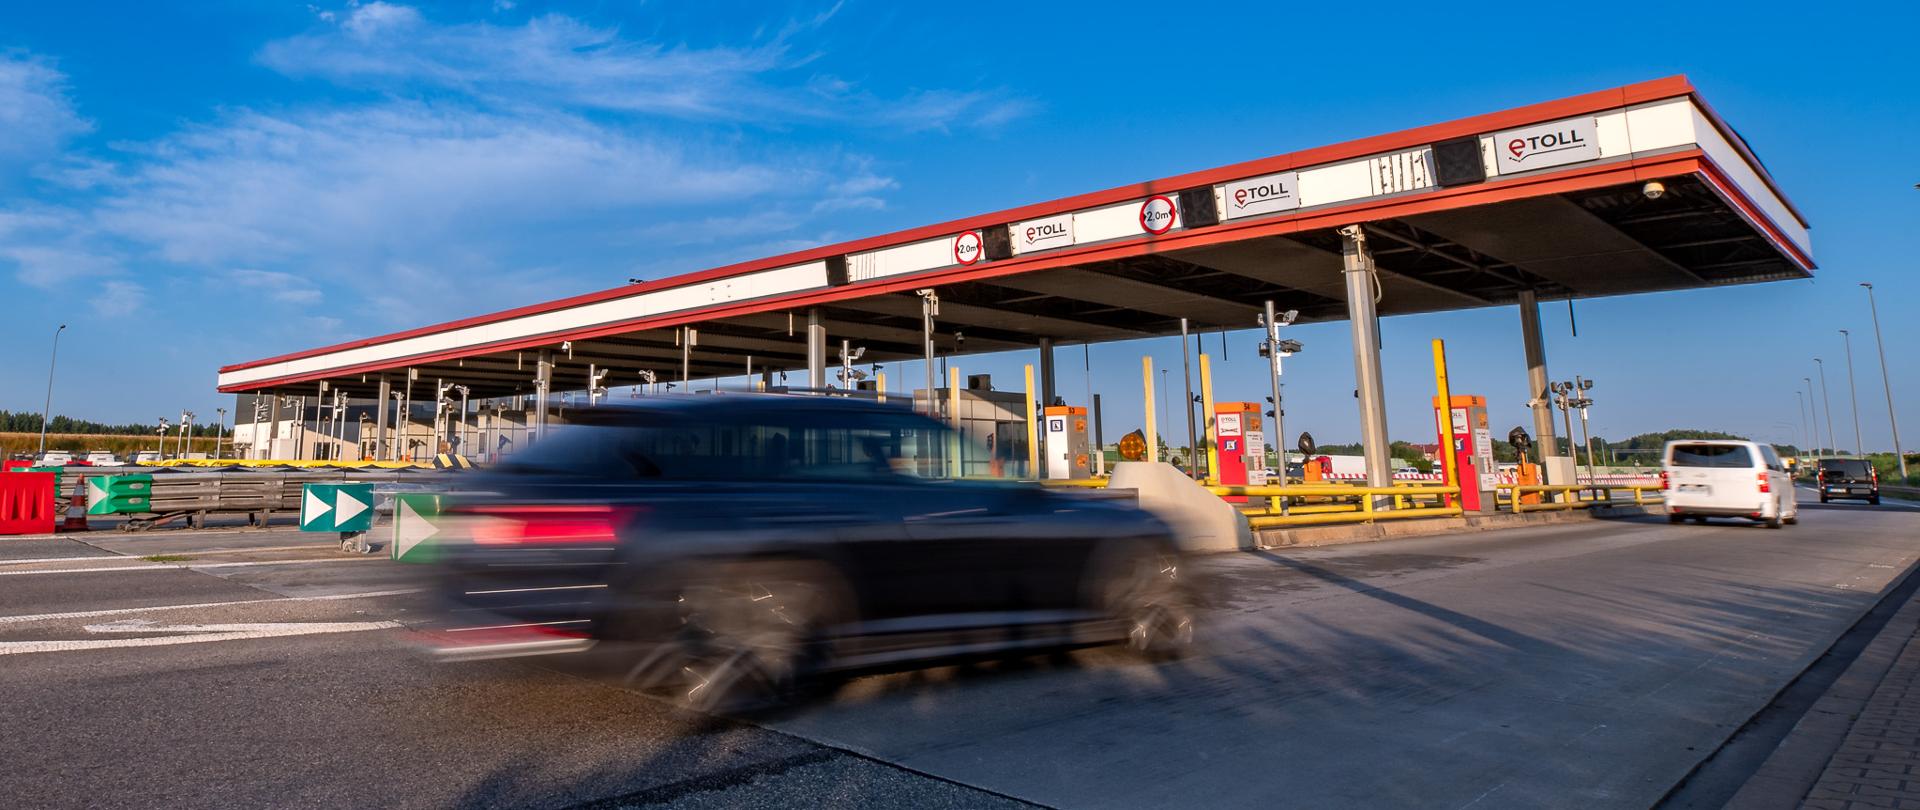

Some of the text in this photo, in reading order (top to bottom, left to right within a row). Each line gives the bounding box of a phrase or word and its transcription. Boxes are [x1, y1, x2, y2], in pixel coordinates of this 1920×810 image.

[1509, 130, 1584, 157] eTOLL
[1235, 183, 1289, 205] eTOLL
[1026, 223, 1066, 241] eTOLL
